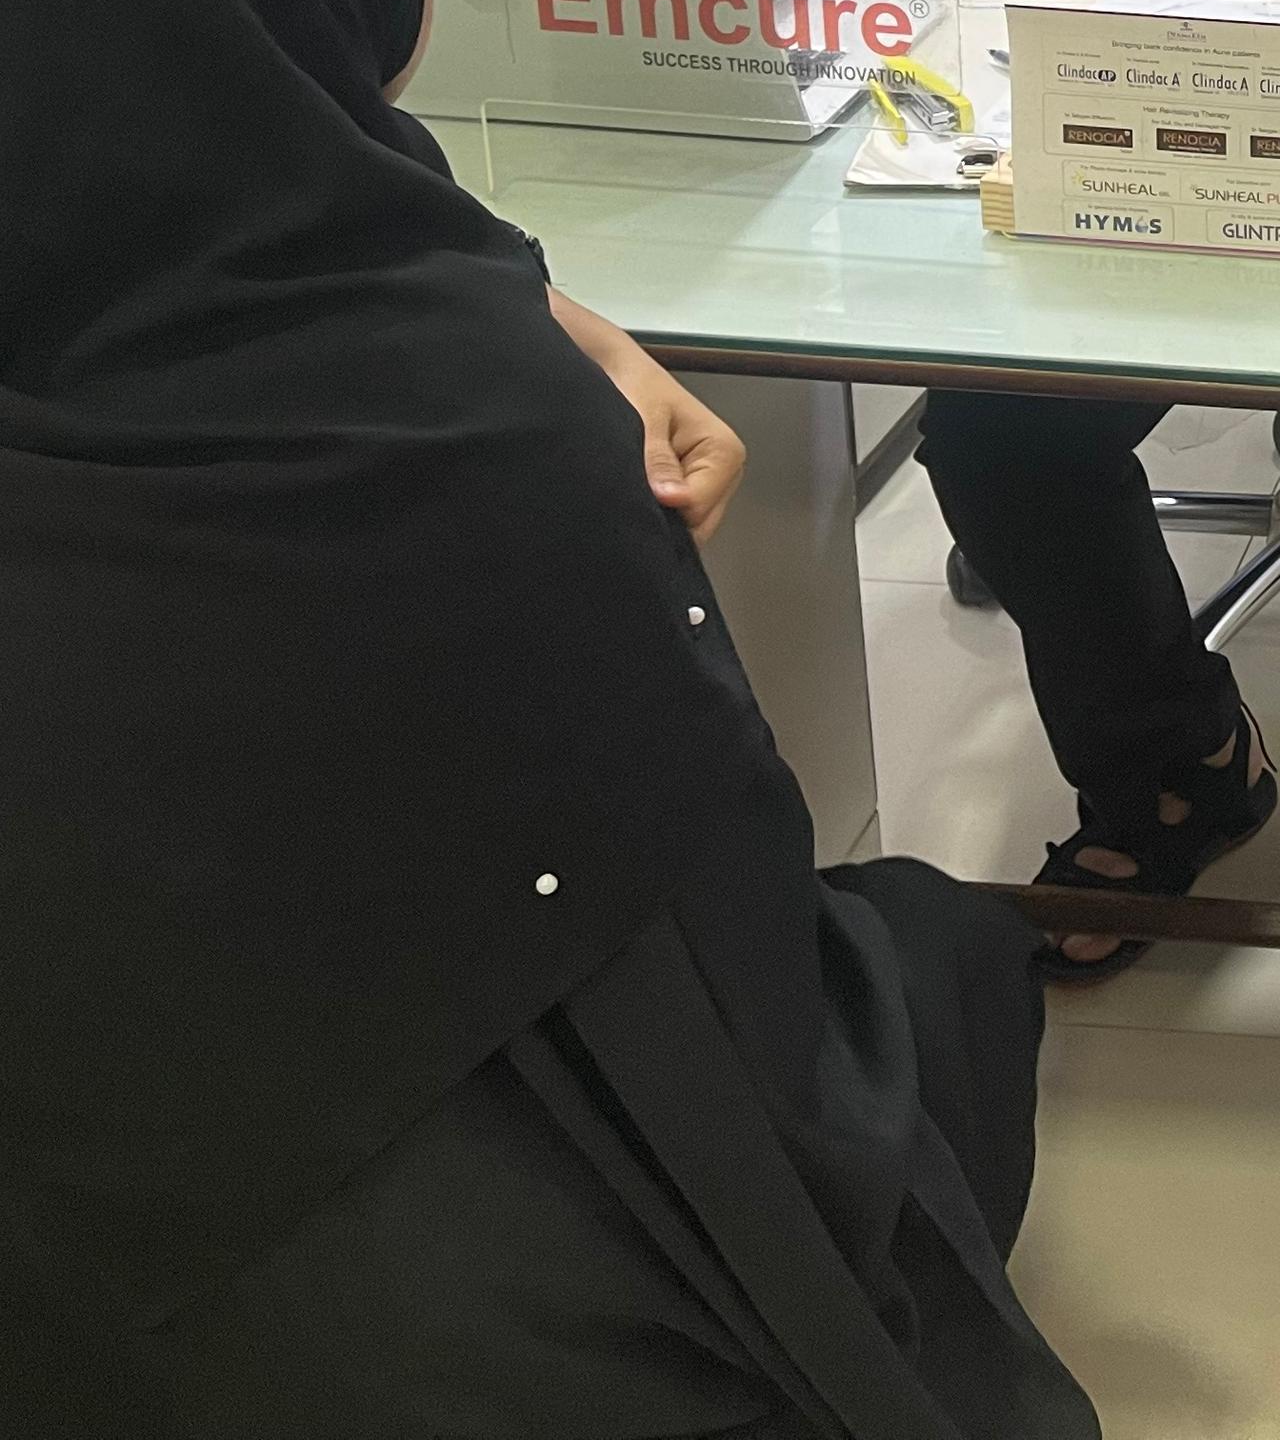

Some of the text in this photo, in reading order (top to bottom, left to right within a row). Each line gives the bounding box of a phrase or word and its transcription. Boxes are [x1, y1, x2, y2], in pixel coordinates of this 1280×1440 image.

[642, 50, 916, 86] SUCCESS THROUGH INNOVATION
[1126, 68, 1181, 86] Clindac A
[1192, 73, 1249, 91] Clindac A
[1068, 130, 1127, 145] RENOCIA
[1163, 133, 1222, 148] RENOCIA
[1082, 179, 1158, 197] SUNHEAL
[1194, 188, 1265, 205] SUNHEAL
